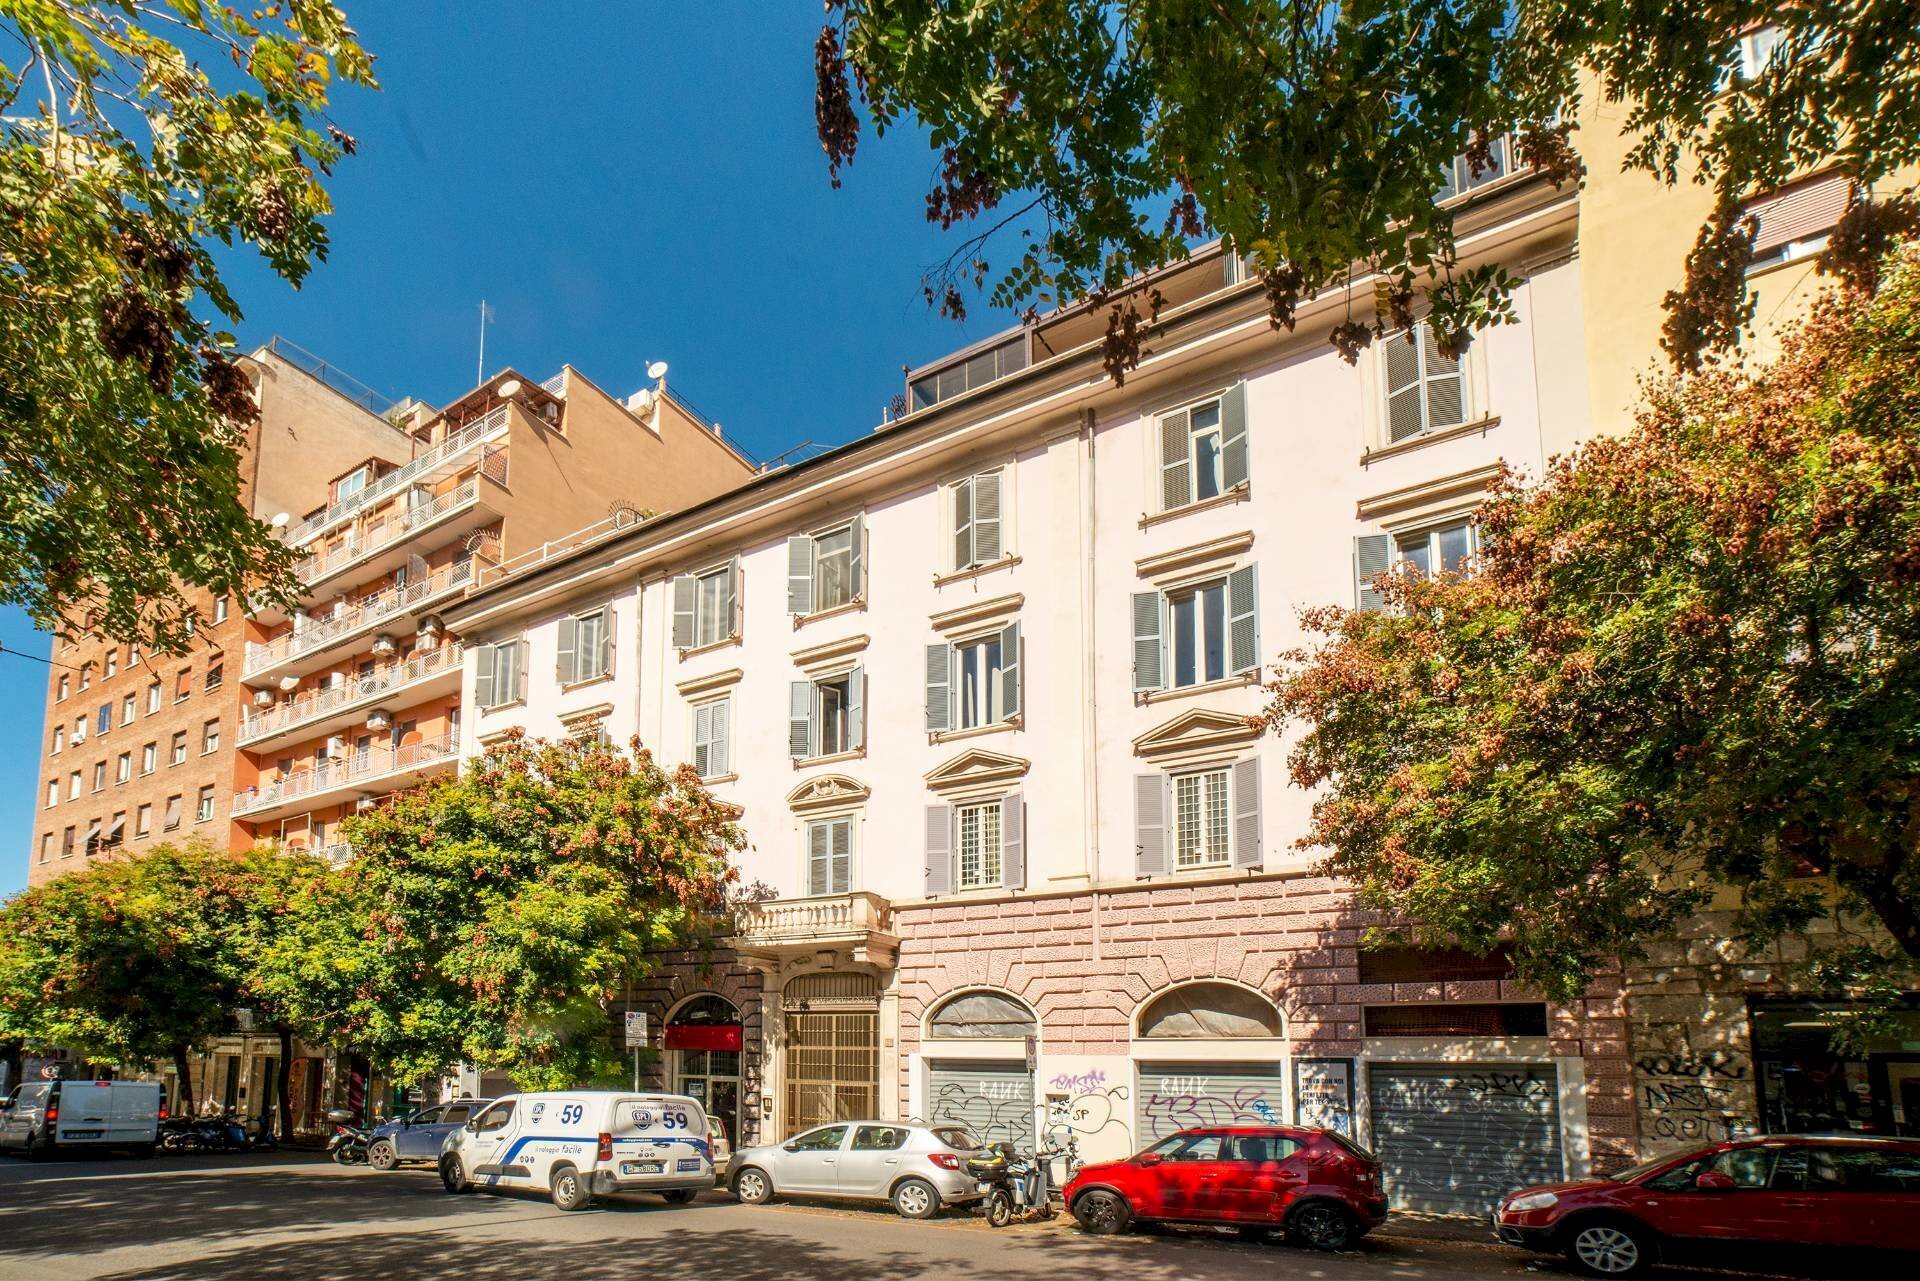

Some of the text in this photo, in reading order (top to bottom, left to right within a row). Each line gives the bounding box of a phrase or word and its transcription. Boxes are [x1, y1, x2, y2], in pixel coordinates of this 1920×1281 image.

[561, 1104, 584, 1125] 59
[663, 1111, 689, 1130] 59
[562, 1144, 582, 1154] facile
